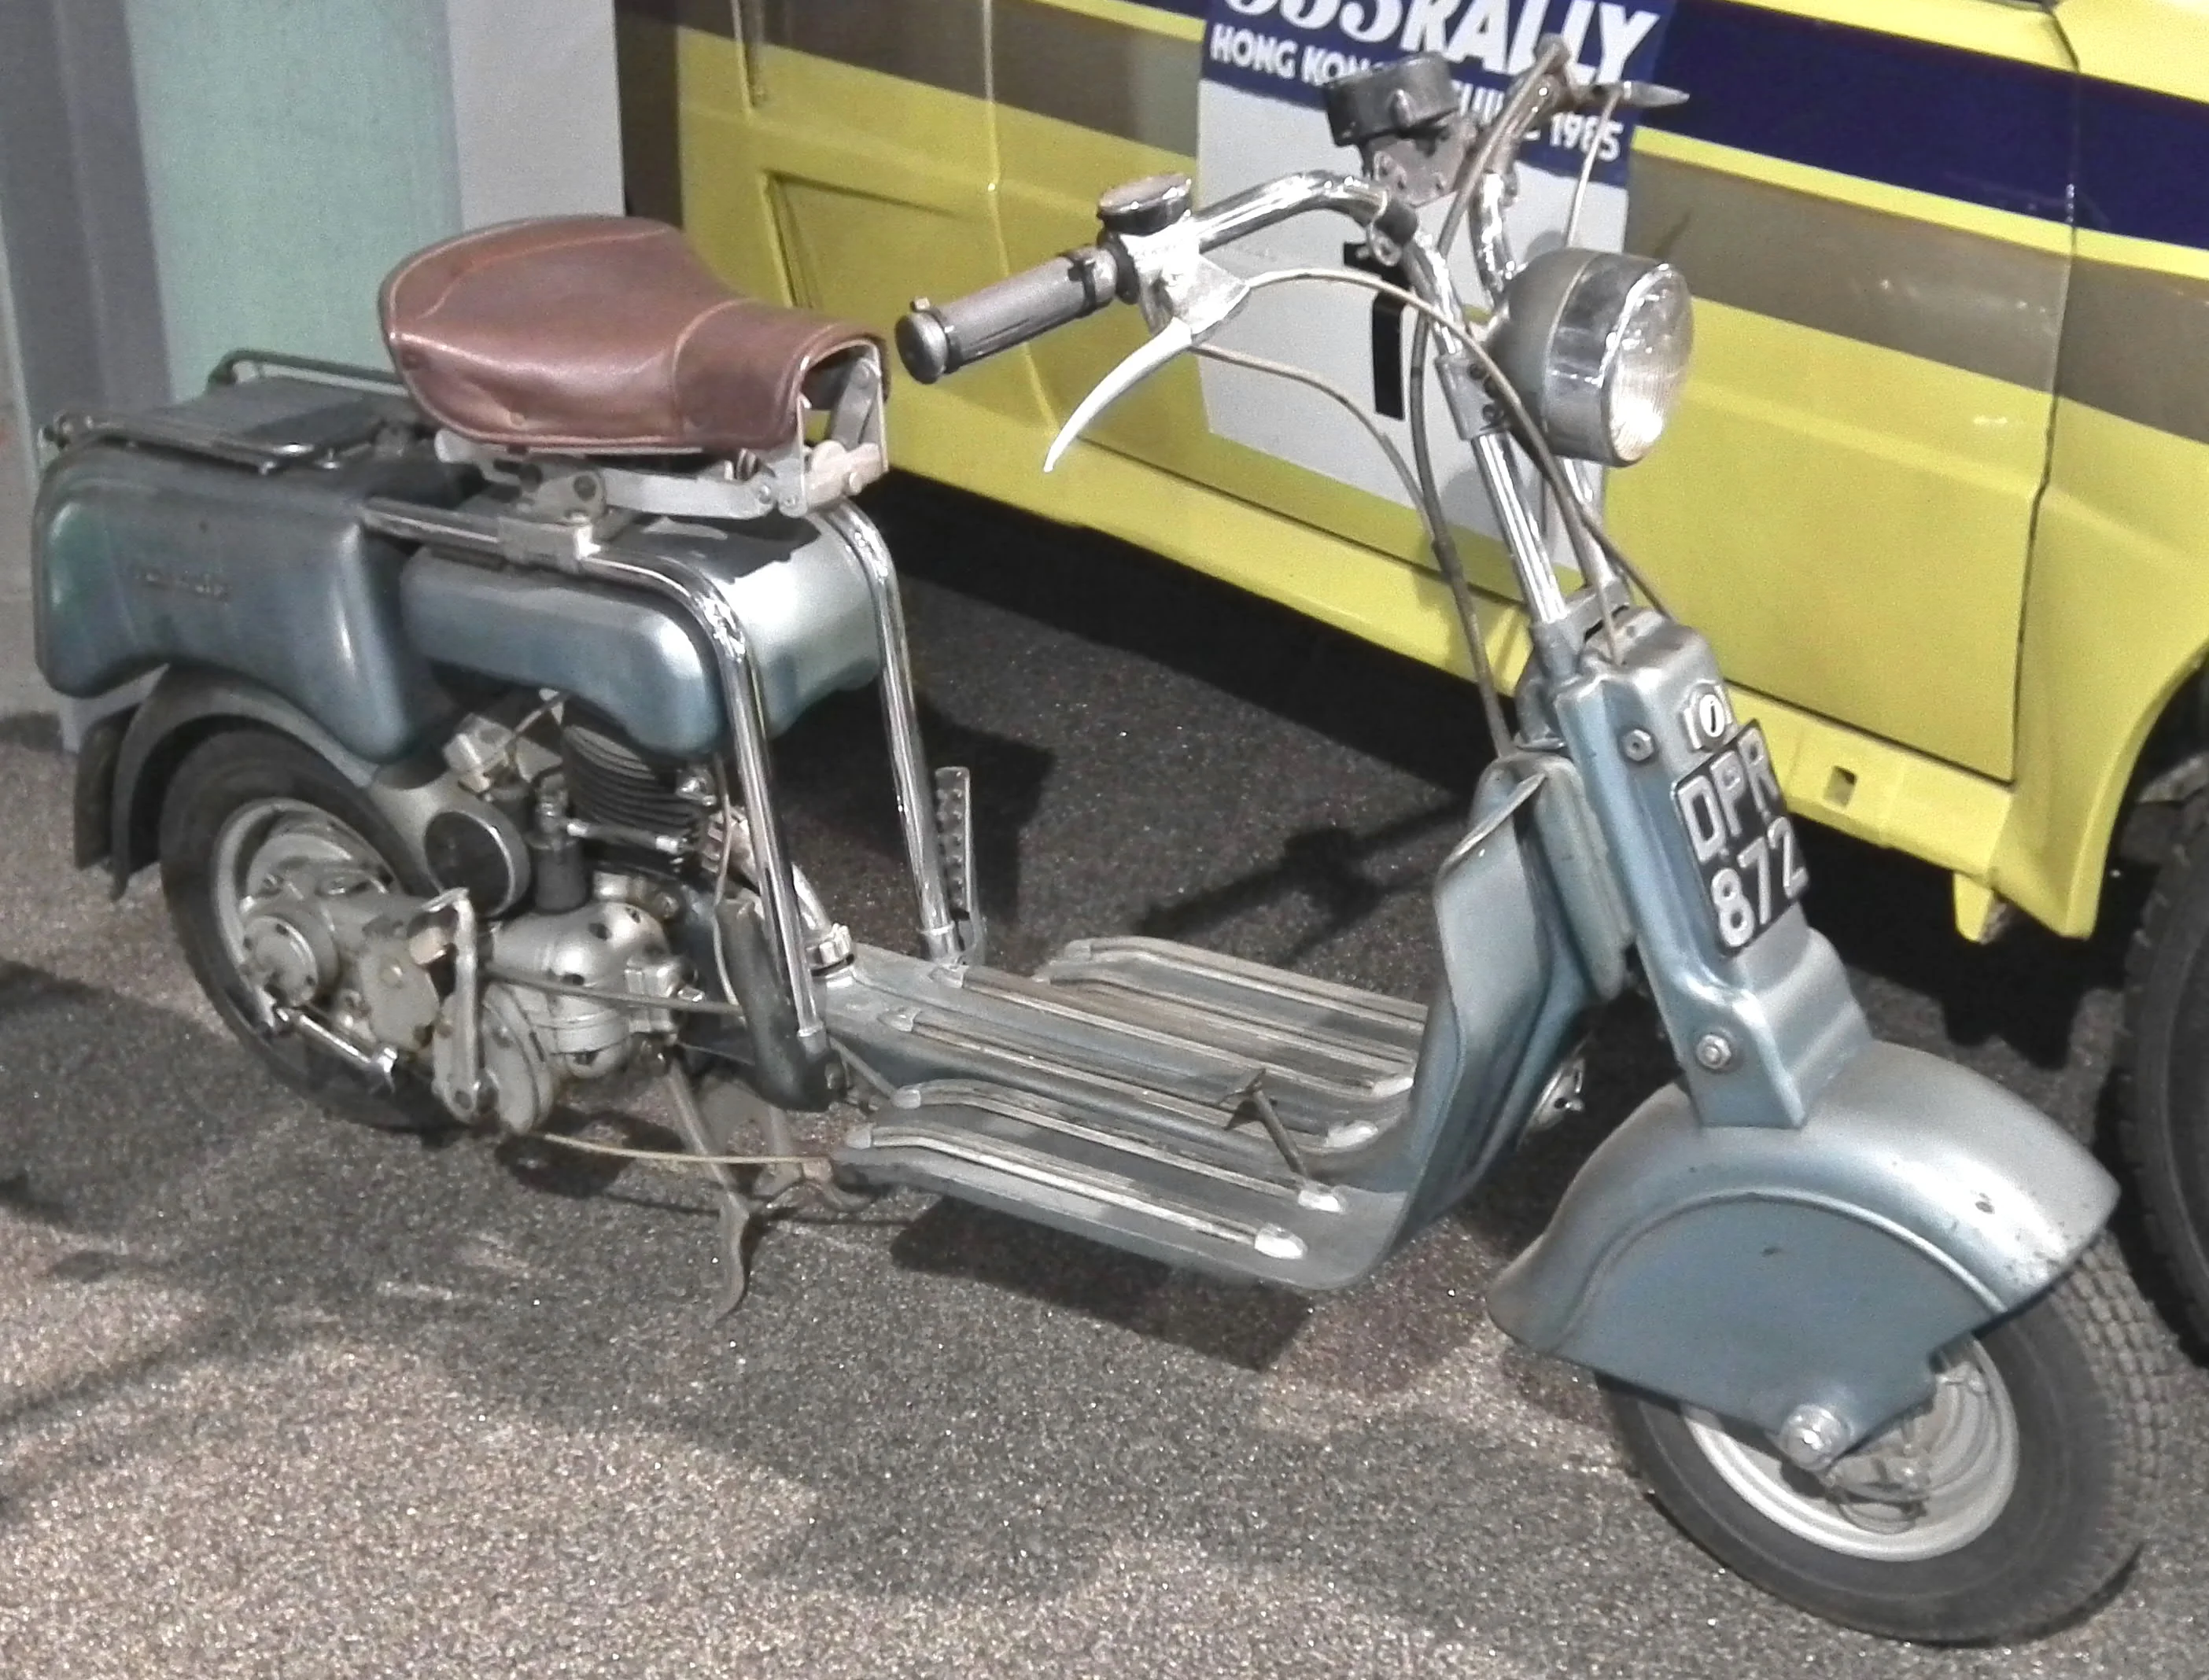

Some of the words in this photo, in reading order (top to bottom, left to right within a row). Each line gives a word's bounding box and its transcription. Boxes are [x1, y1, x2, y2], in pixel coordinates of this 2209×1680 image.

[1210, 23, 1298, 79] HONG
[1300, 45, 1382, 86] KO
[1550, 111, 1624, 161] 1985
[1676, 727, 1780, 863] DPR
[1710, 816, 1809, 947] 872
